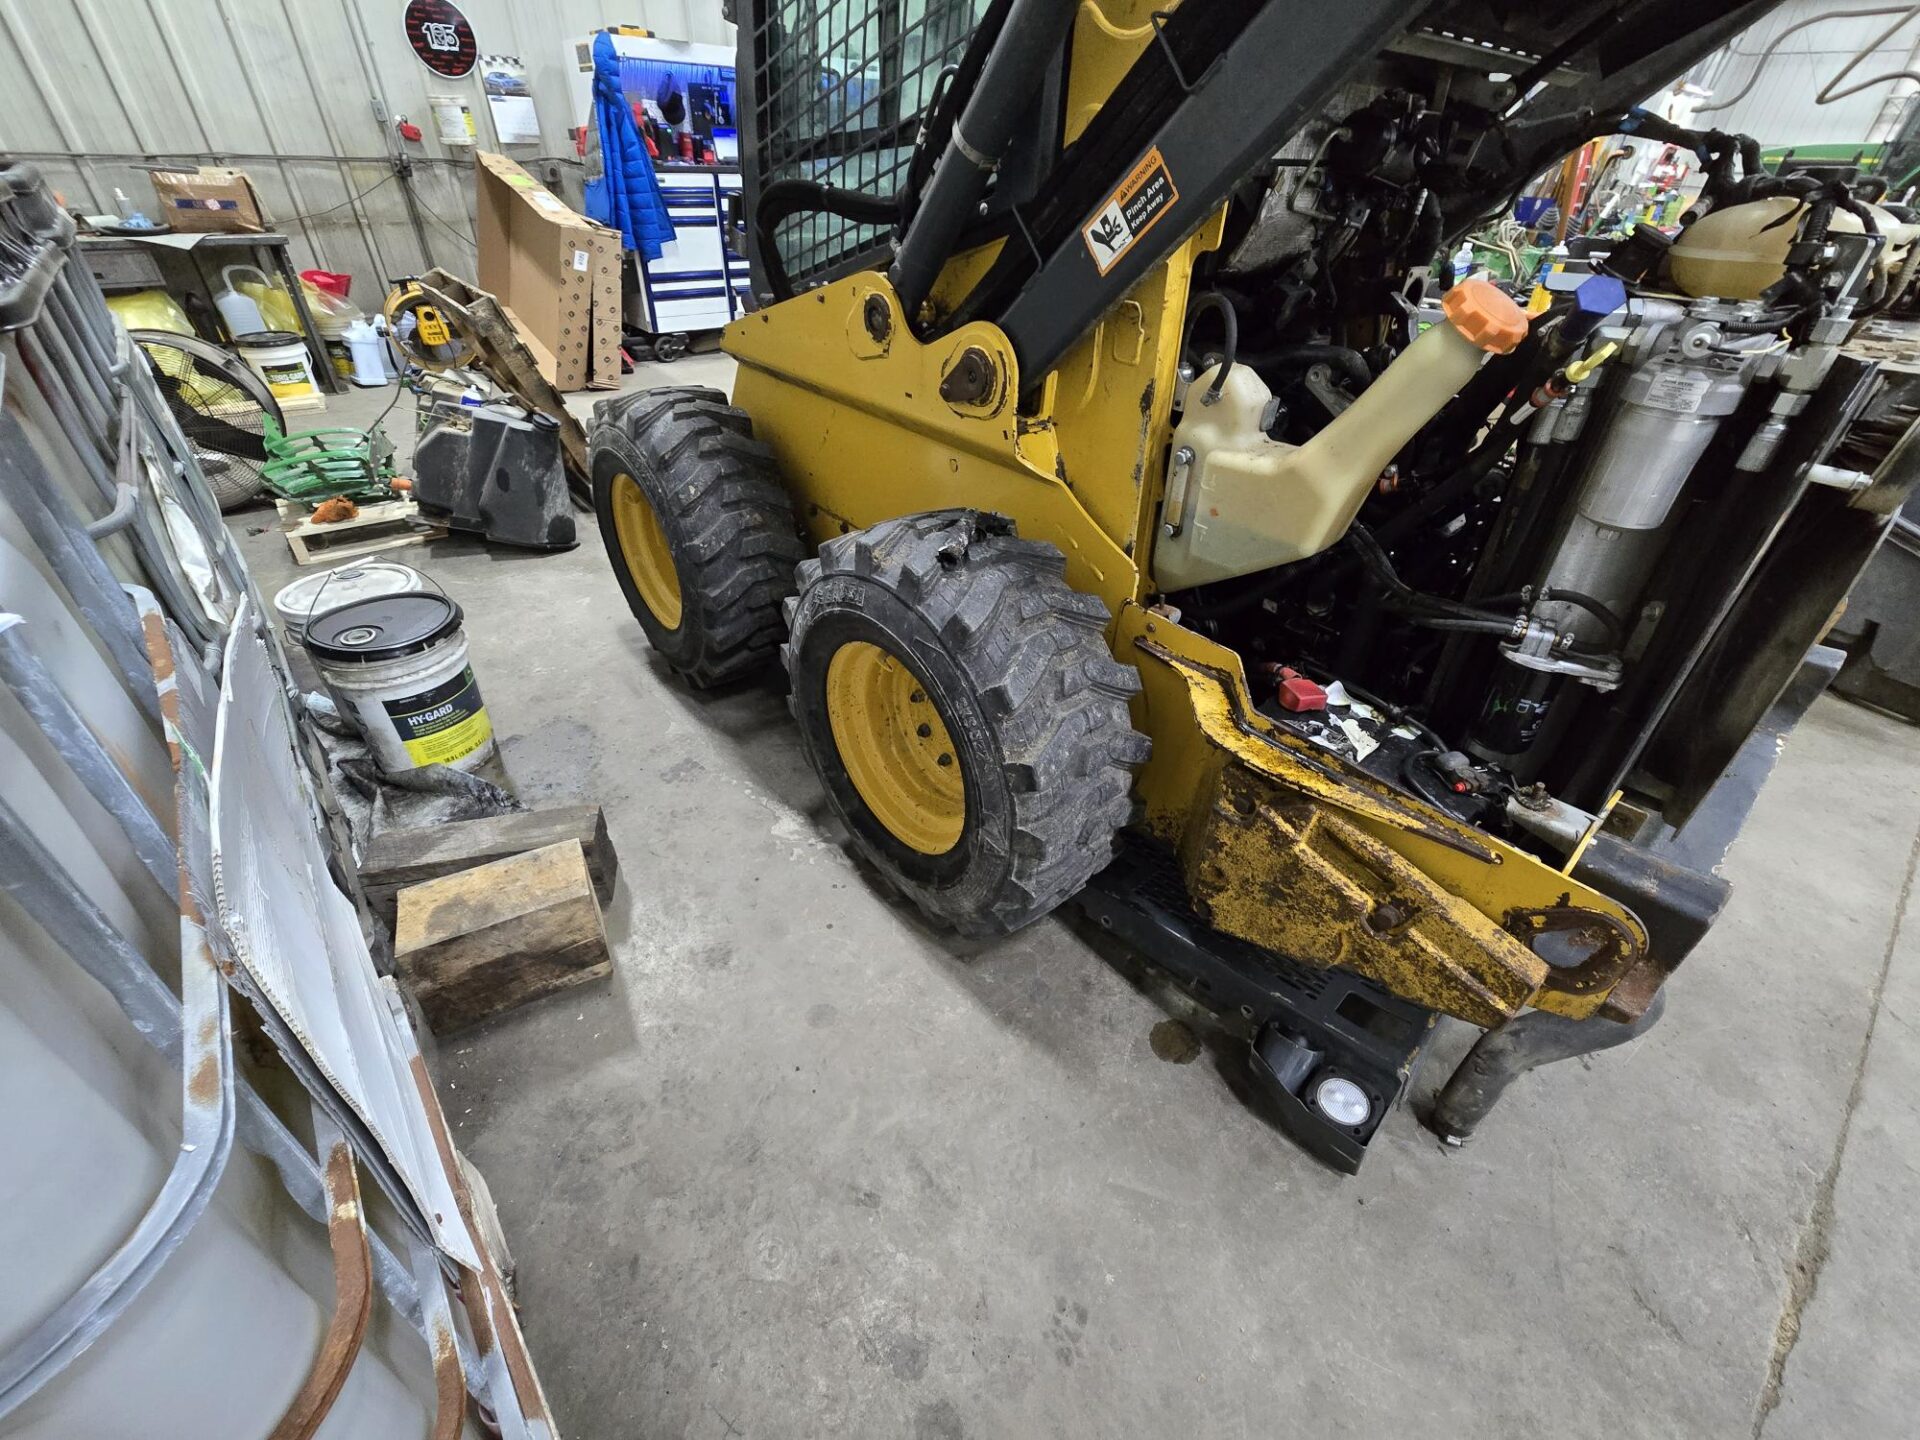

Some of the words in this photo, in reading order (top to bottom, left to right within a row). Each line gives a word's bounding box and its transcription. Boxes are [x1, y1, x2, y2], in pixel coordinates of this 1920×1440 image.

[1125, 156, 1157, 193] WARNING
[1126, 195, 1147, 219] Pinch
[1146, 176, 1165, 198] Area
[1131, 211, 1148, 230] Keep
[1146, 192, 1164, 214] Away
[407, 703, 453, 726] HY-GARD
